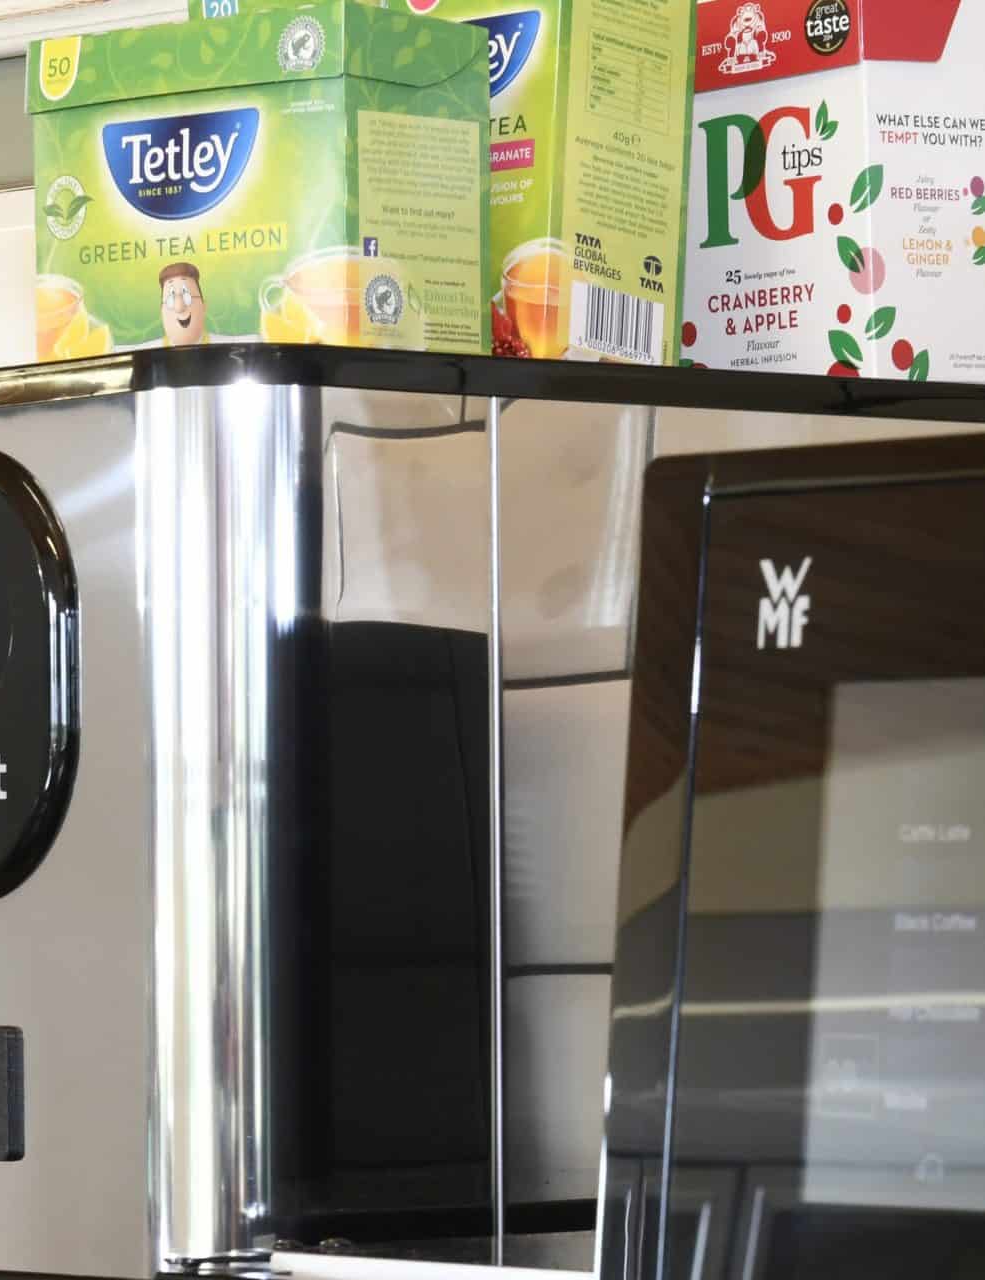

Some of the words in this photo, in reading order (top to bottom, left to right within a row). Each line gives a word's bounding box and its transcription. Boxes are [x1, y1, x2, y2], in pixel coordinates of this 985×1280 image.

[816, 3, 838, 19] great
[806, 15, 850, 37] taste
[771, 30, 792, 43] 1930
[47, 56, 71, 78] 50
[876, 113, 910, 127] WHAT
[913, 115, 940, 128] ELSE
[943, 116, 966, 129] CAN
[969, 118, 985, 131] WE
[880, 130, 919, 144] TEMPT
[922, 132, 946, 145] YOU
[949, 134, 983, 147] WITH?
[121, 127, 239, 193] Tetley
[698, 106, 822, 248] PG
[781, 144, 823, 176] tips
[138, 187, 162, 198] SINCE
[890, 186, 913, 200] RED
[916, 188, 960, 201] BERRIES
[79, 241, 147, 264] GREEN
[156, 236, 196, 256] TEA
[207, 228, 282, 252] LEMON
[575, 233, 601, 248] TATA
[902, 238, 943, 250] LEMON
[574, 246, 607, 264] GLOBAL
[907, 253, 950, 265] GINGER
[573, 258, 621, 281] BEVERAGES
[725, 269, 741, 285] 25
[639, 277, 664, 293] TATA
[708, 282, 814, 313] CRANBERRY
[725, 318, 736, 335] &
[743, 310, 798, 334] APPLE
[746, 340, 780, 352] Flavour
[730, 358, 759, 367] HERBAL
[761, 353, 797, 365] INFUSION
